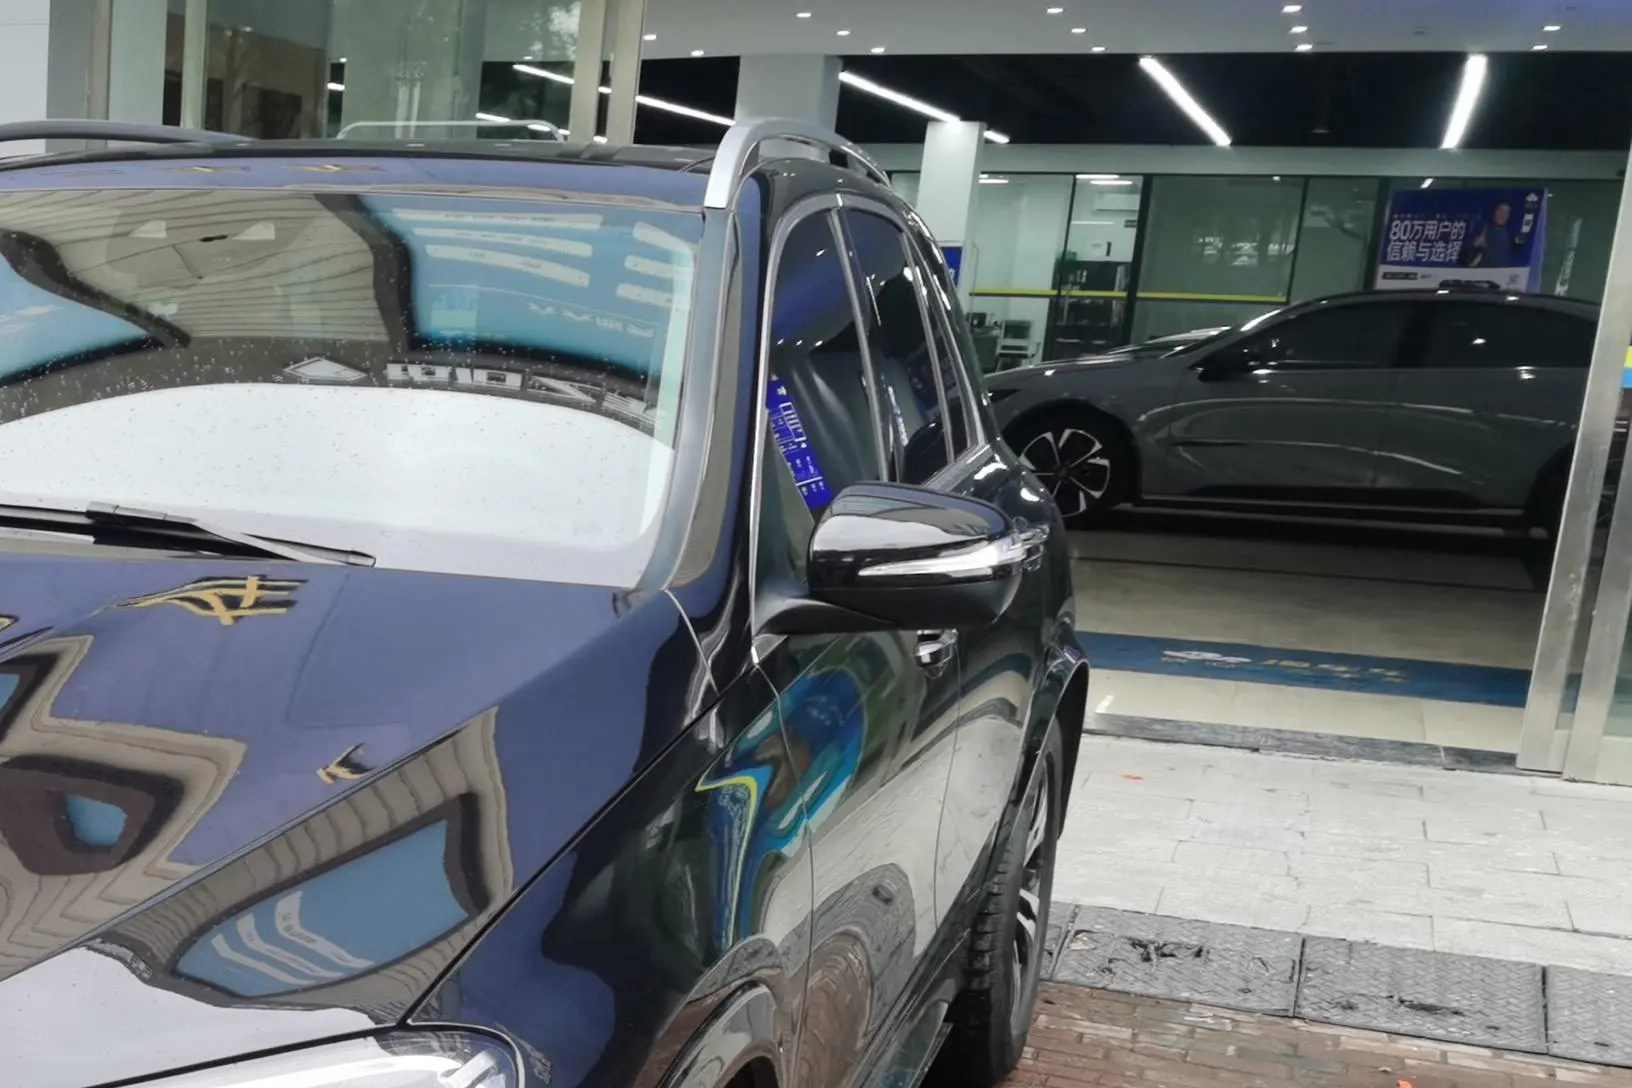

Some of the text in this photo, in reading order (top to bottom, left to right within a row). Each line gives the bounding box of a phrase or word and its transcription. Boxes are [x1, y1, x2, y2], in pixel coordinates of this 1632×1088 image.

[1389, 219, 1466, 240] 80万用户的
[1386, 241, 1463, 262] 信赖与选择
